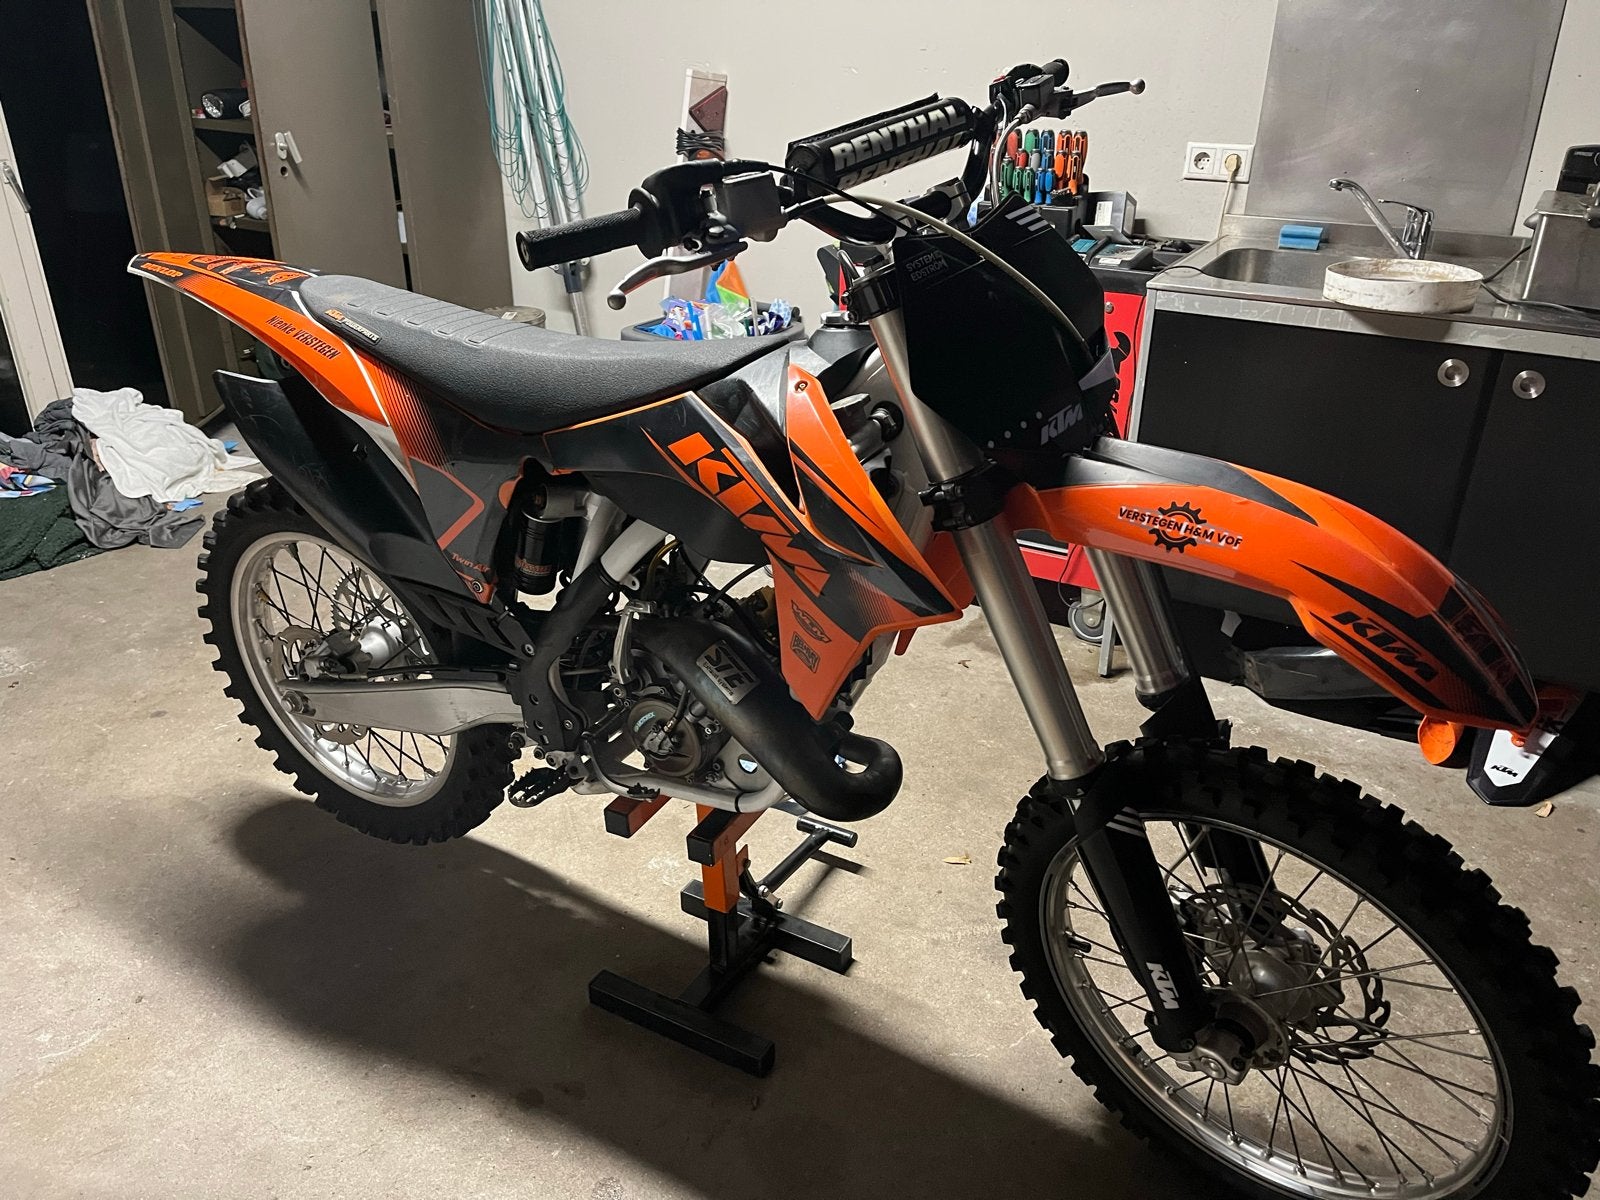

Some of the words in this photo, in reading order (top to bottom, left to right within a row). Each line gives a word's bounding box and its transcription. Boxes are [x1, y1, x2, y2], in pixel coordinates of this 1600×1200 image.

[829, 104, 967, 172] RENTHAL
[904, 250, 937, 273] SYSTEM
[266, 315, 296, 335] Nienke
[293, 329, 341, 360] VERSTEGEN
[1040, 402, 1084, 446] KTM
[667, 431, 830, 597] KTM
[1119, 507, 1184, 533] VERSTEGEN
[1183, 523, 1215, 541] H&M
[1217, 532, 1243, 547] VOF
[1331, 611, 1439, 682] KTM
[1491, 763, 1519, 779] KTM
[1146, 961, 1180, 1010] KTM
